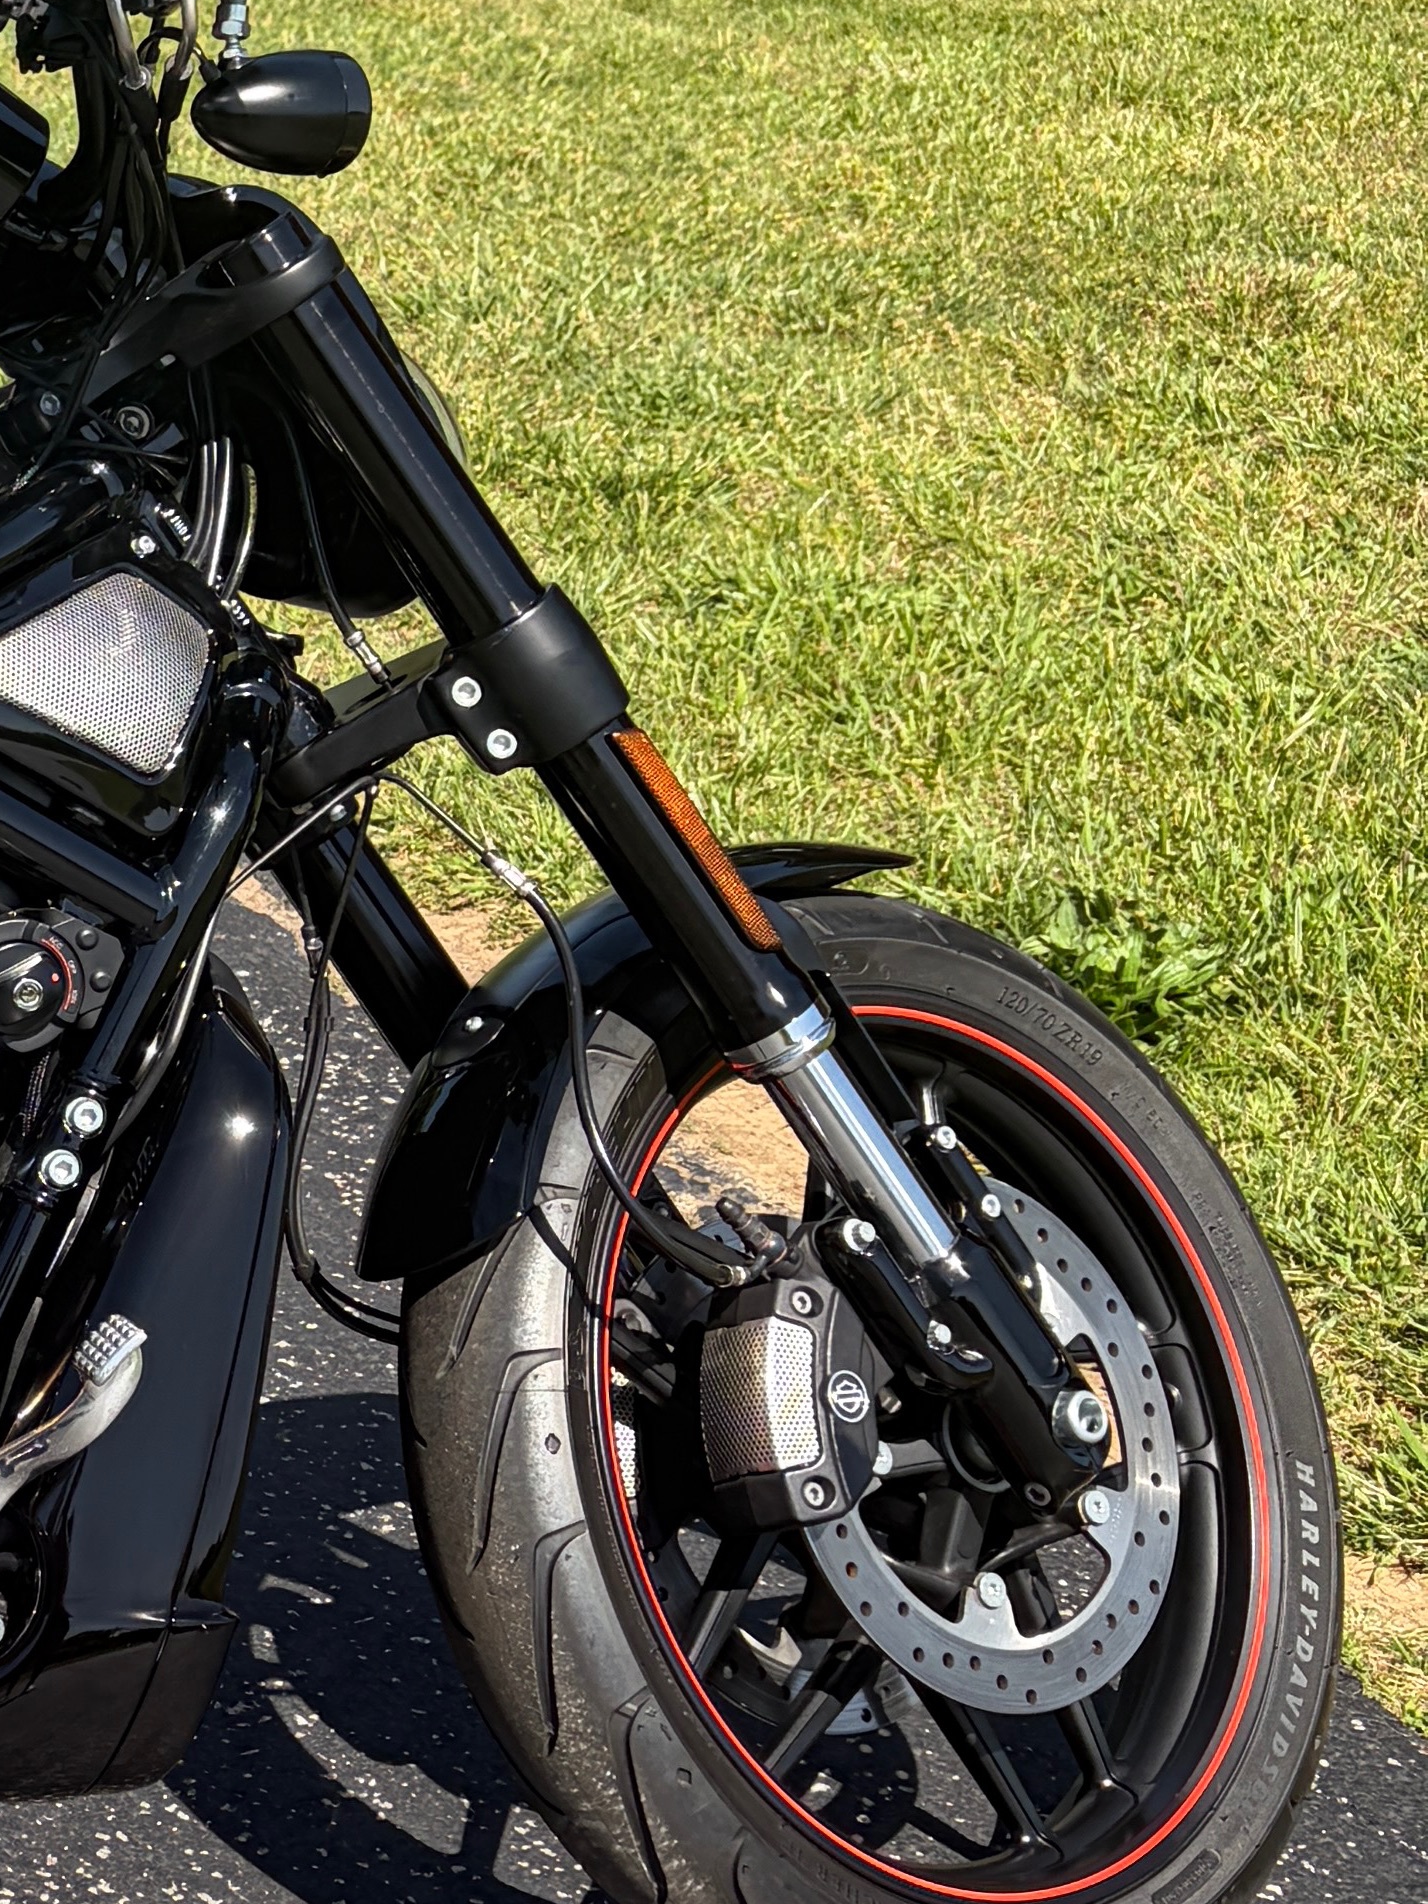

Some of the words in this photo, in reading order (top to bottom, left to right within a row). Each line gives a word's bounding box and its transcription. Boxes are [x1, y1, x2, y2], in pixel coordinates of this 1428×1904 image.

[996, 986, 1052, 1031] 120/70
[1051, 1020, 1104, 1067] ZR19
[1241, 1458, 1320, 1818] HARLEY-DAVIDSO
